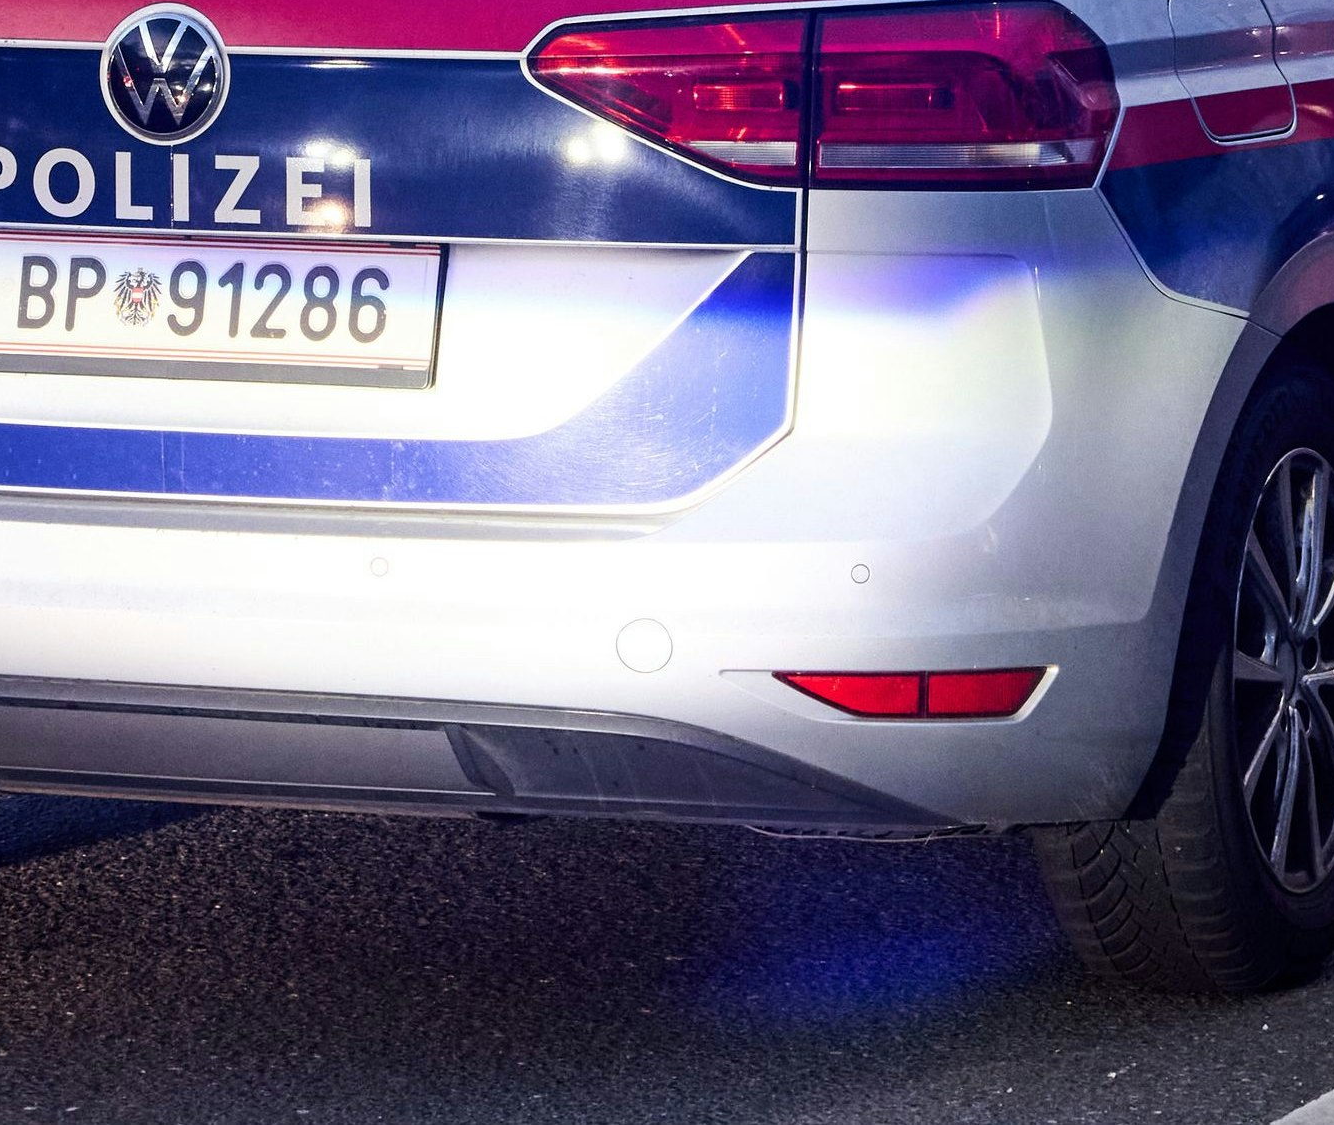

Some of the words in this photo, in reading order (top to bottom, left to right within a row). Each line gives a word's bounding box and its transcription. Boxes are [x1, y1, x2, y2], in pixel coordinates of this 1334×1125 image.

[105, 13, 223, 133] VW
[16, 254, 107, 332] BP
[166, 259, 391, 344] 91286
